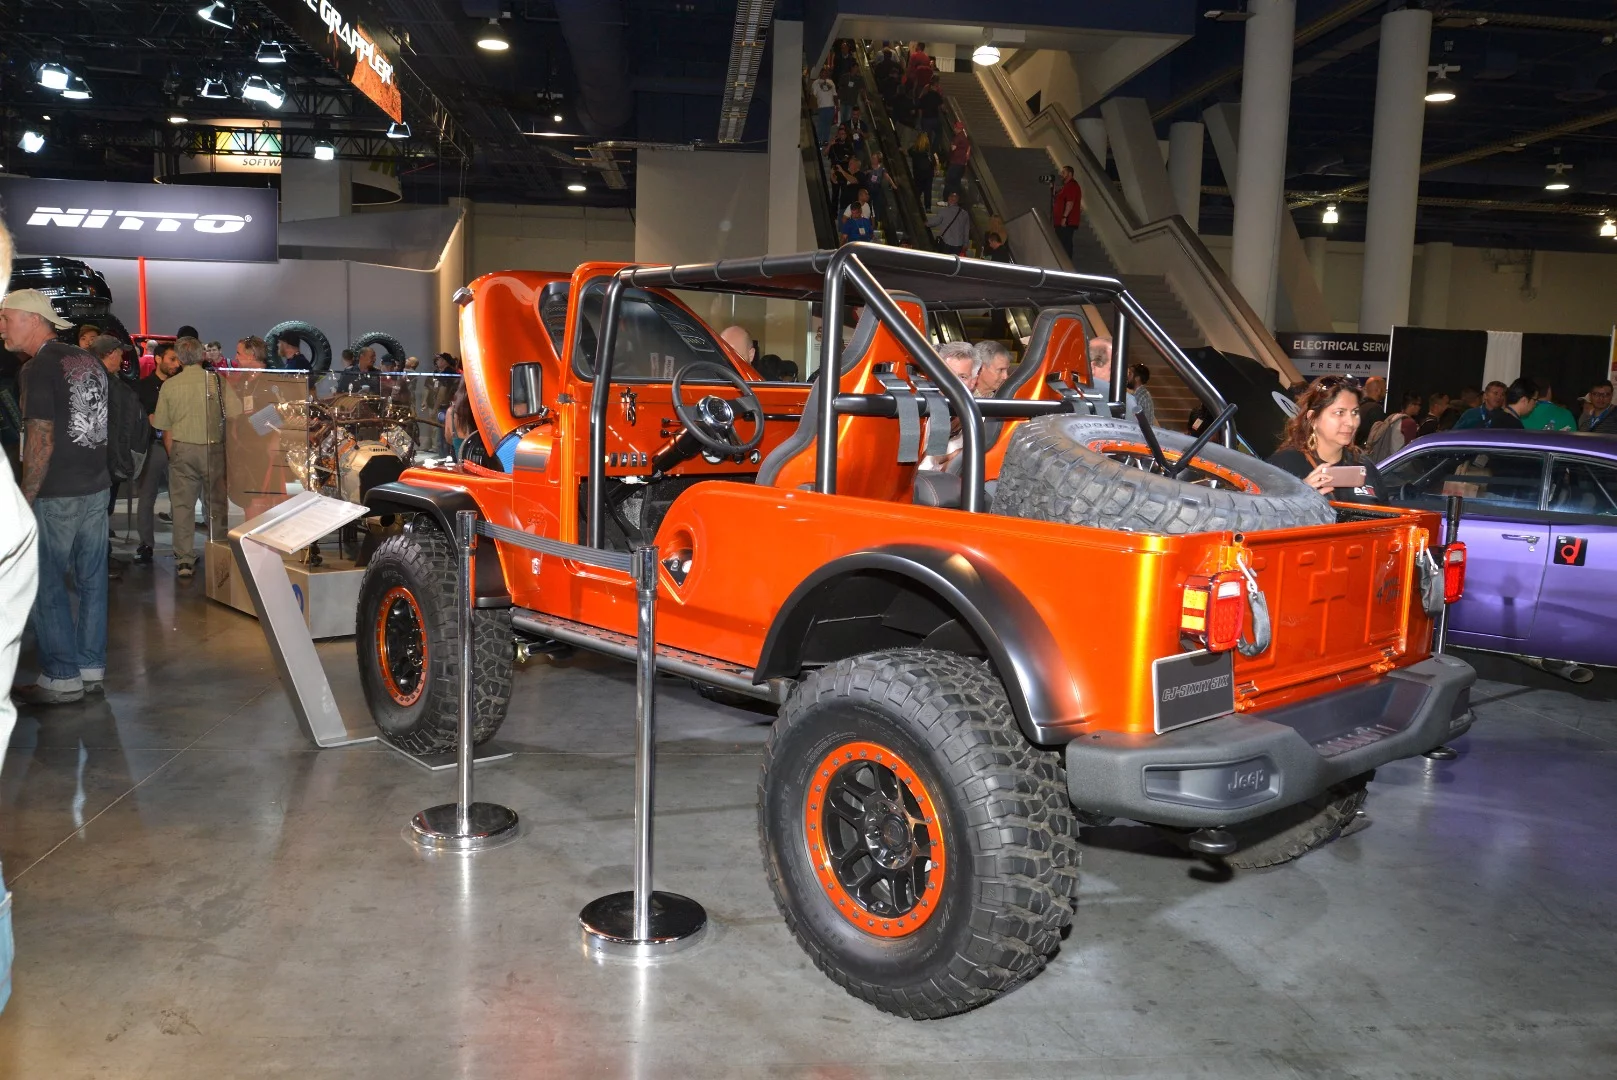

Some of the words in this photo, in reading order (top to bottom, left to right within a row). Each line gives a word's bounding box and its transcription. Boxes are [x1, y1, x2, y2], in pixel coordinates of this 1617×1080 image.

[1293, 340, 1360, 351] ELECTRICAL
[1362, 341, 1390, 353] SERVI
[1310, 361, 1371, 370] FREEMAN
[1161, 678, 1212, 702] CJ-SIXTY
[1211, 674, 1230, 690] SIX
[1227, 769, 1265, 791] Jeep
